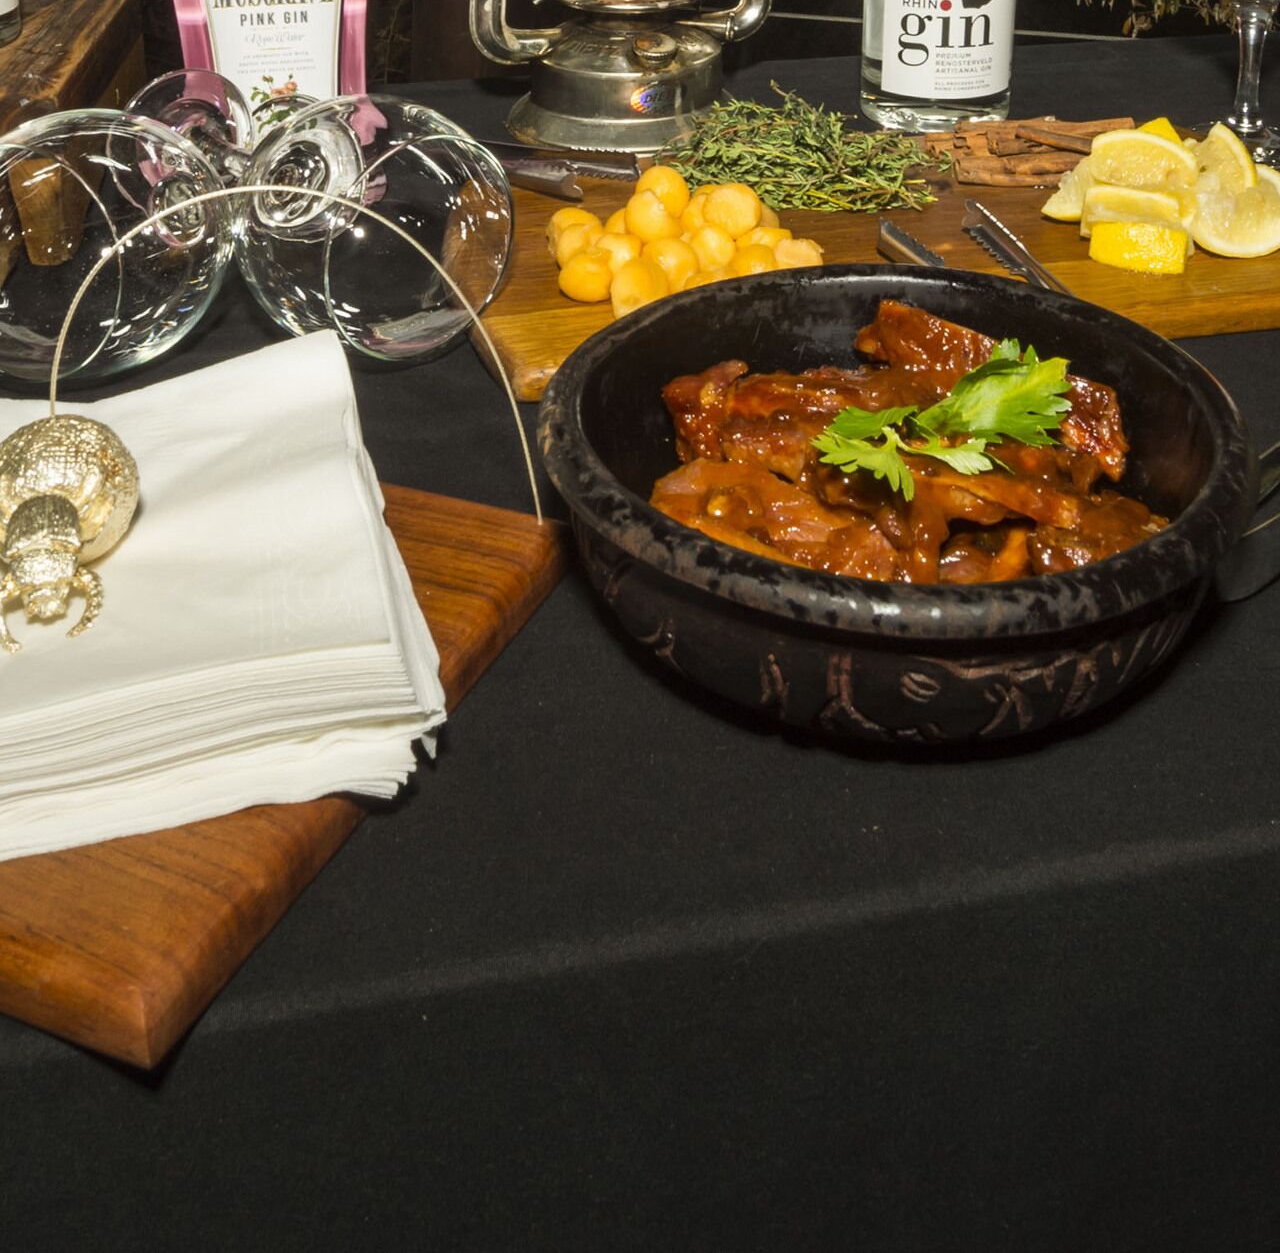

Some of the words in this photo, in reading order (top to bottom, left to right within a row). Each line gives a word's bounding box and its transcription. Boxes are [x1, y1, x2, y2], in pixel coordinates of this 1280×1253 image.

[239, 11, 275, 27] PINK
[283, 10, 309, 25] GIN
[897, 12, 995, 67] gin
